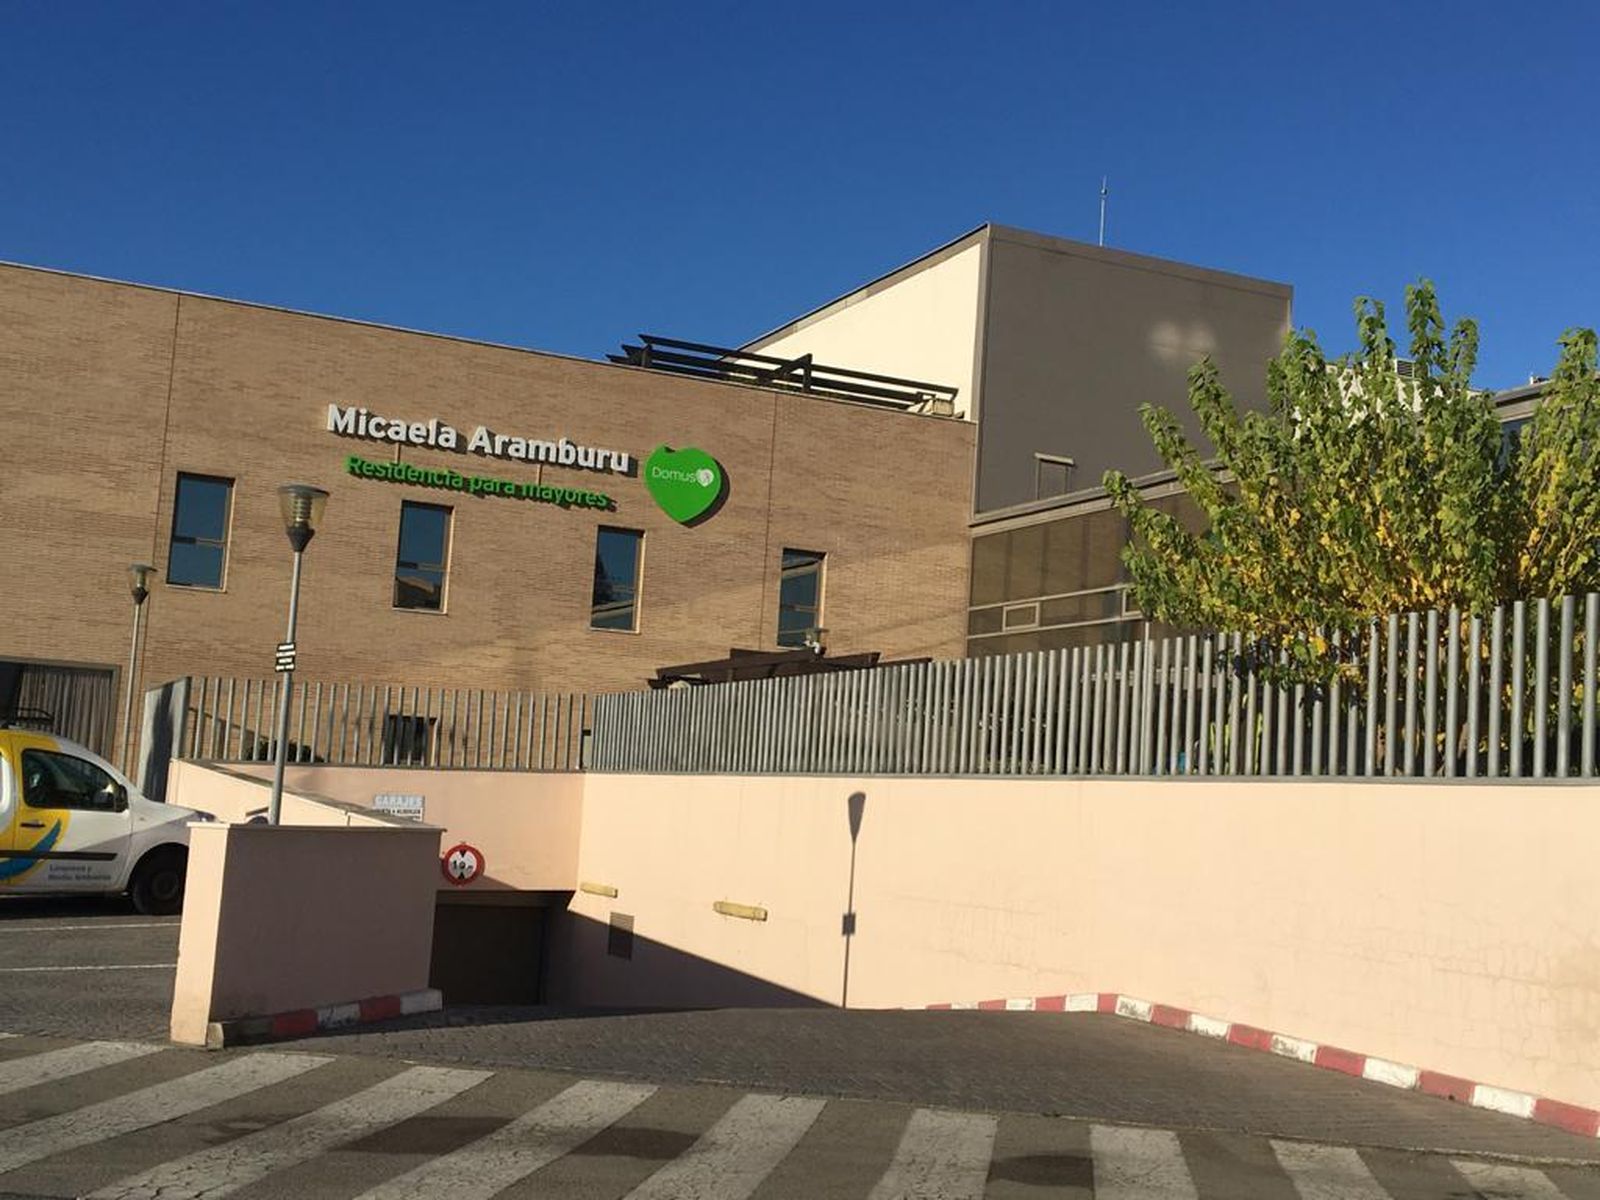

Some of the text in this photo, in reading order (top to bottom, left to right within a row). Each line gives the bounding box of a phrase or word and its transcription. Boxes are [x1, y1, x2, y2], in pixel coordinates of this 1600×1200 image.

[327, 404, 630, 473] Micaela Aramburu
[346, 455, 609, 507] Residencia para mayores
